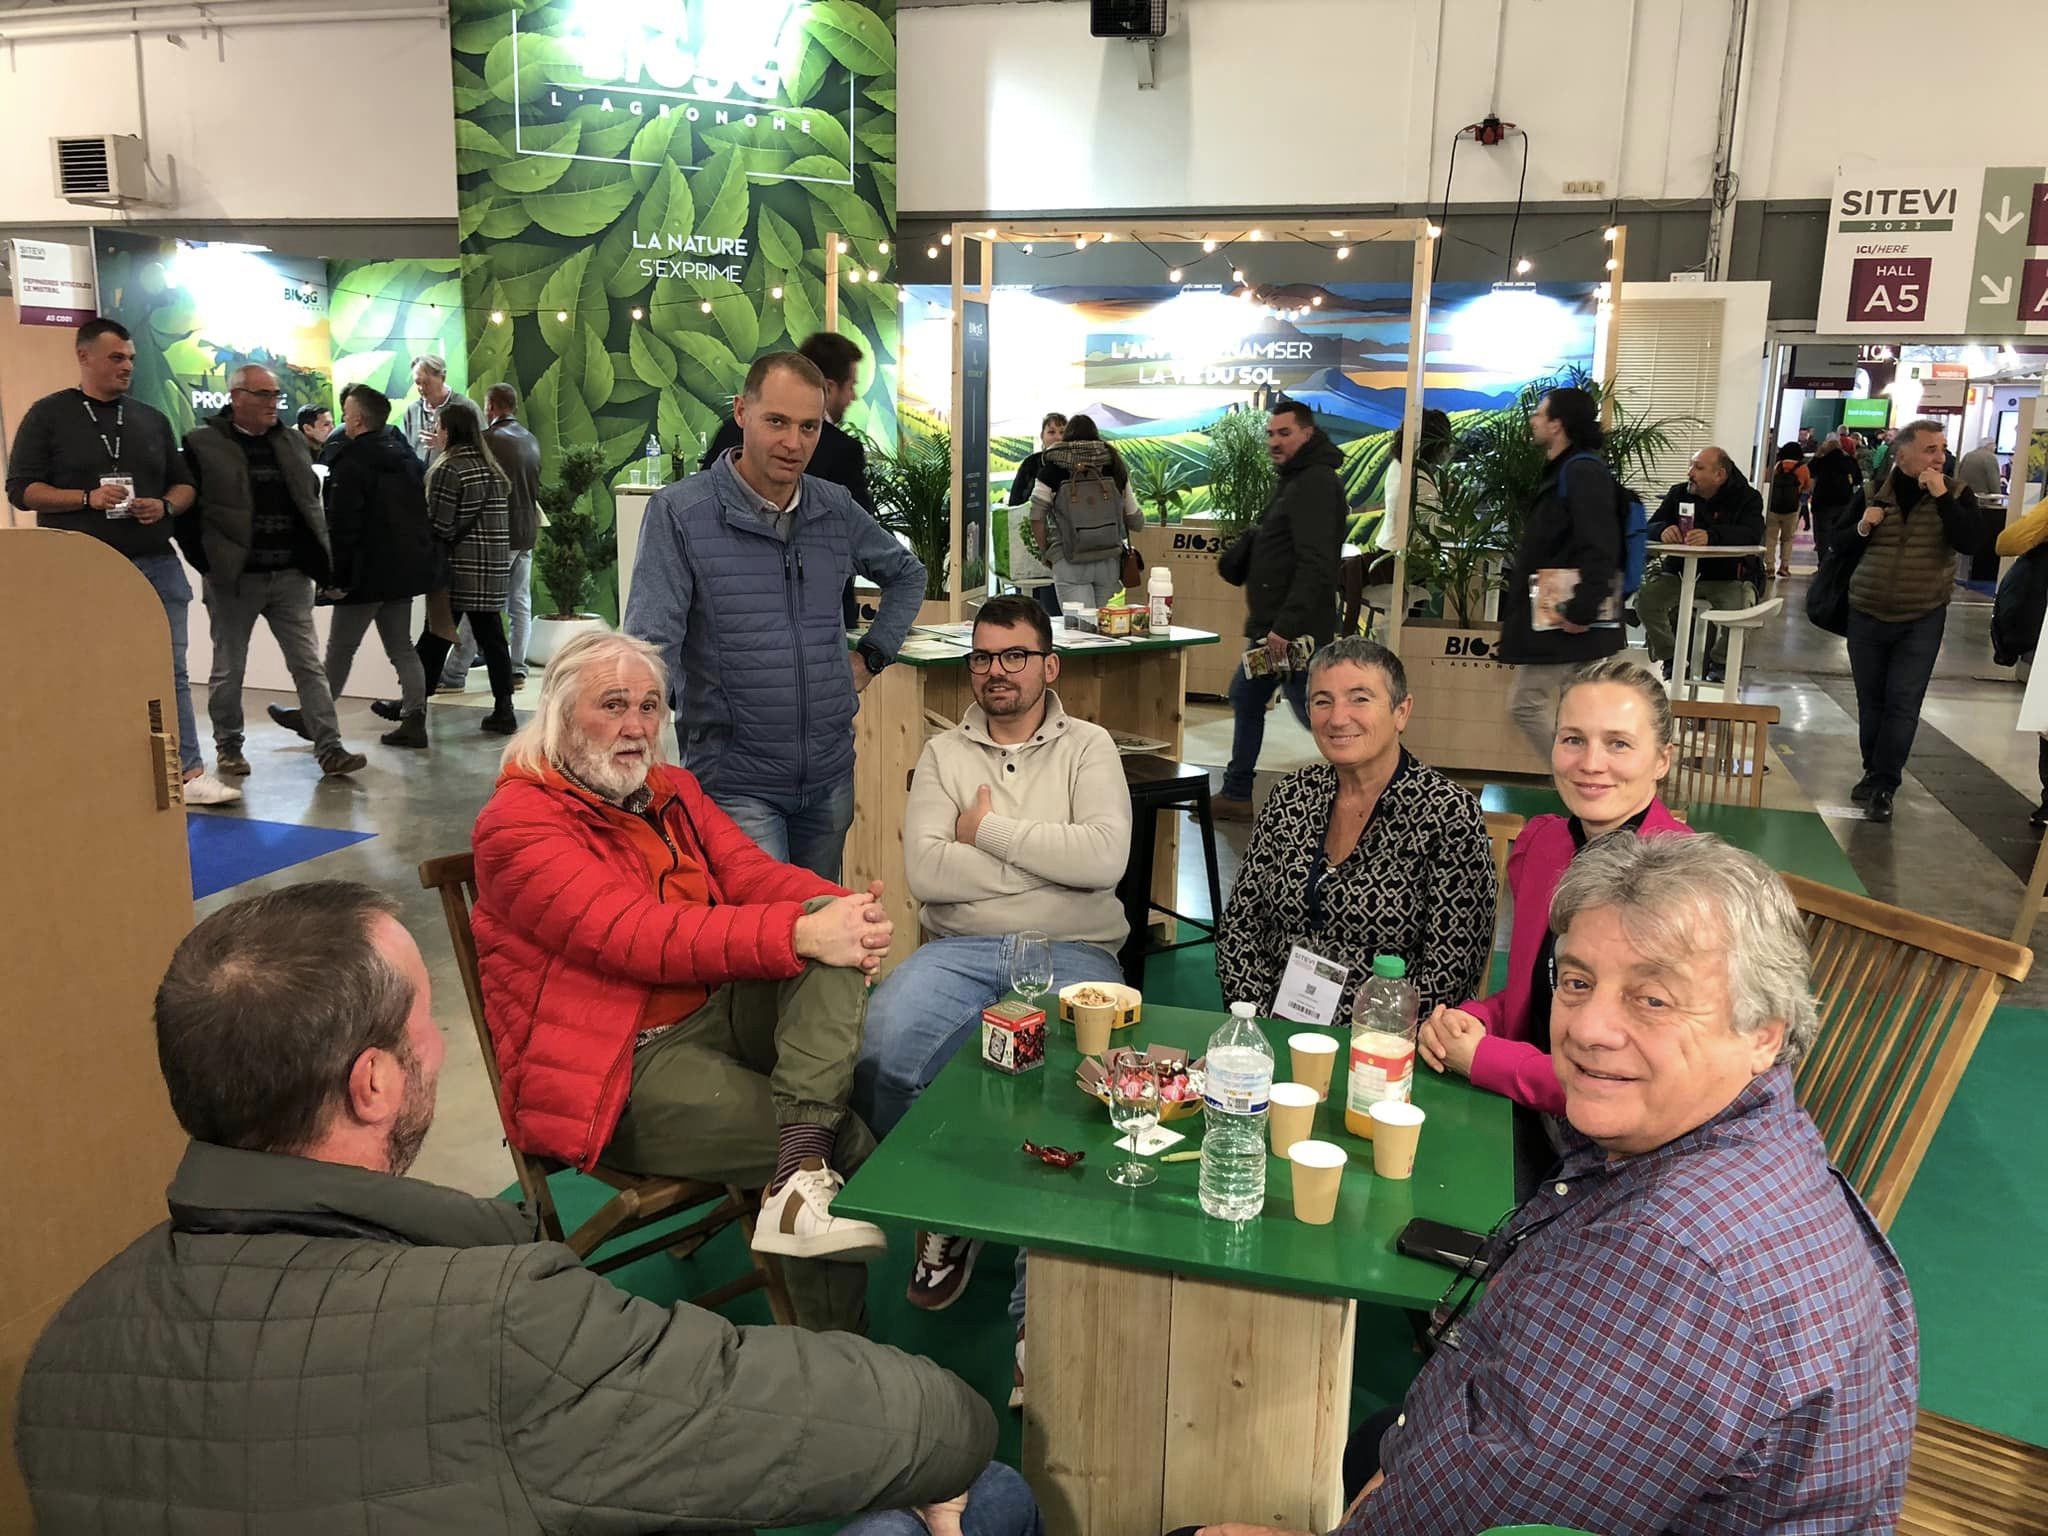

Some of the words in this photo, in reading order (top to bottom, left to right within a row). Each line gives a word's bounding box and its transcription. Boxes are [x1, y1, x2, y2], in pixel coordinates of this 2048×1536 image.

[551, 91, 810, 134] L'AGRONOME
[1841, 188, 1957, 216] SITEVI
[1870, 222, 1921, 231] 2023
[633, 230, 662, 250] LA
[667, 233, 748, 257] NATURE
[1856, 244, 1909, 255] ICI/HERE
[640, 259, 742, 283] S'EXPRIME
[1876, 265, 1915, 277] HALL
[1864, 284, 1920, 313] A5
[1205, 367, 1235, 385] DU
[1238, 367, 1281, 385] SOL
